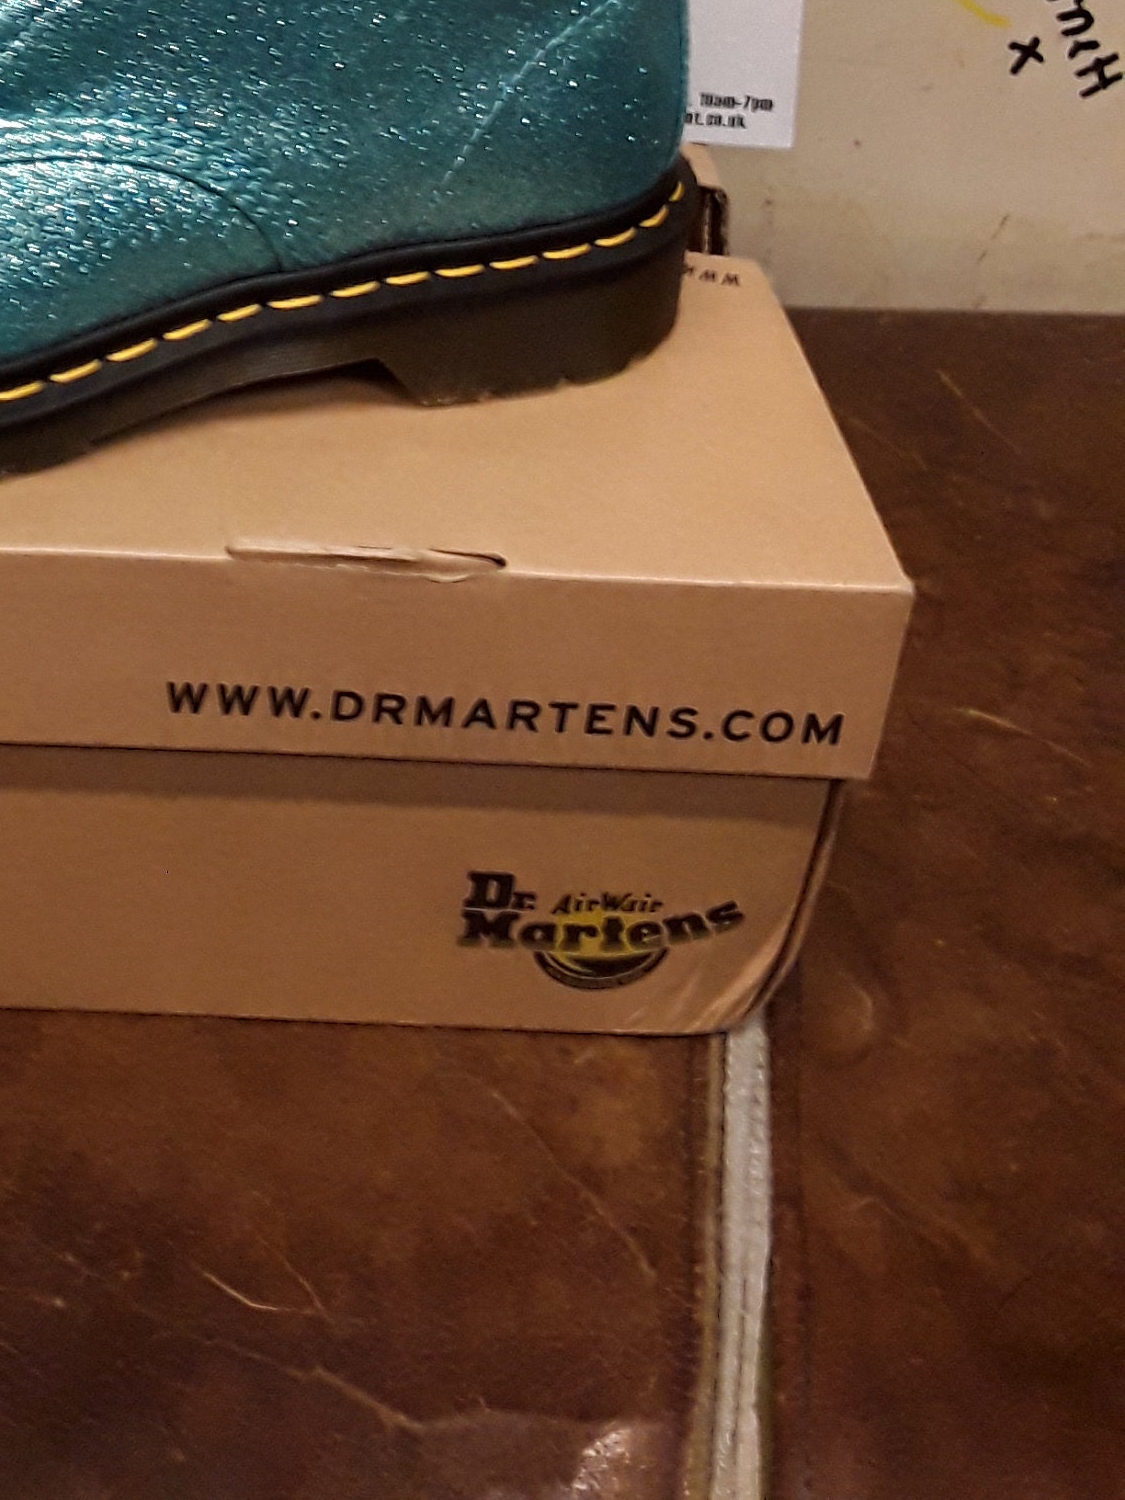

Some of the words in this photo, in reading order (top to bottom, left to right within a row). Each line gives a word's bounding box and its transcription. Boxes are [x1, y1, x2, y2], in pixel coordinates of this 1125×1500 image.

[167, 680, 846, 747] WWW.DRMARTENS.COM
[458, 900, 745, 949] Martens
[552, 892, 665, 916] AirWair
